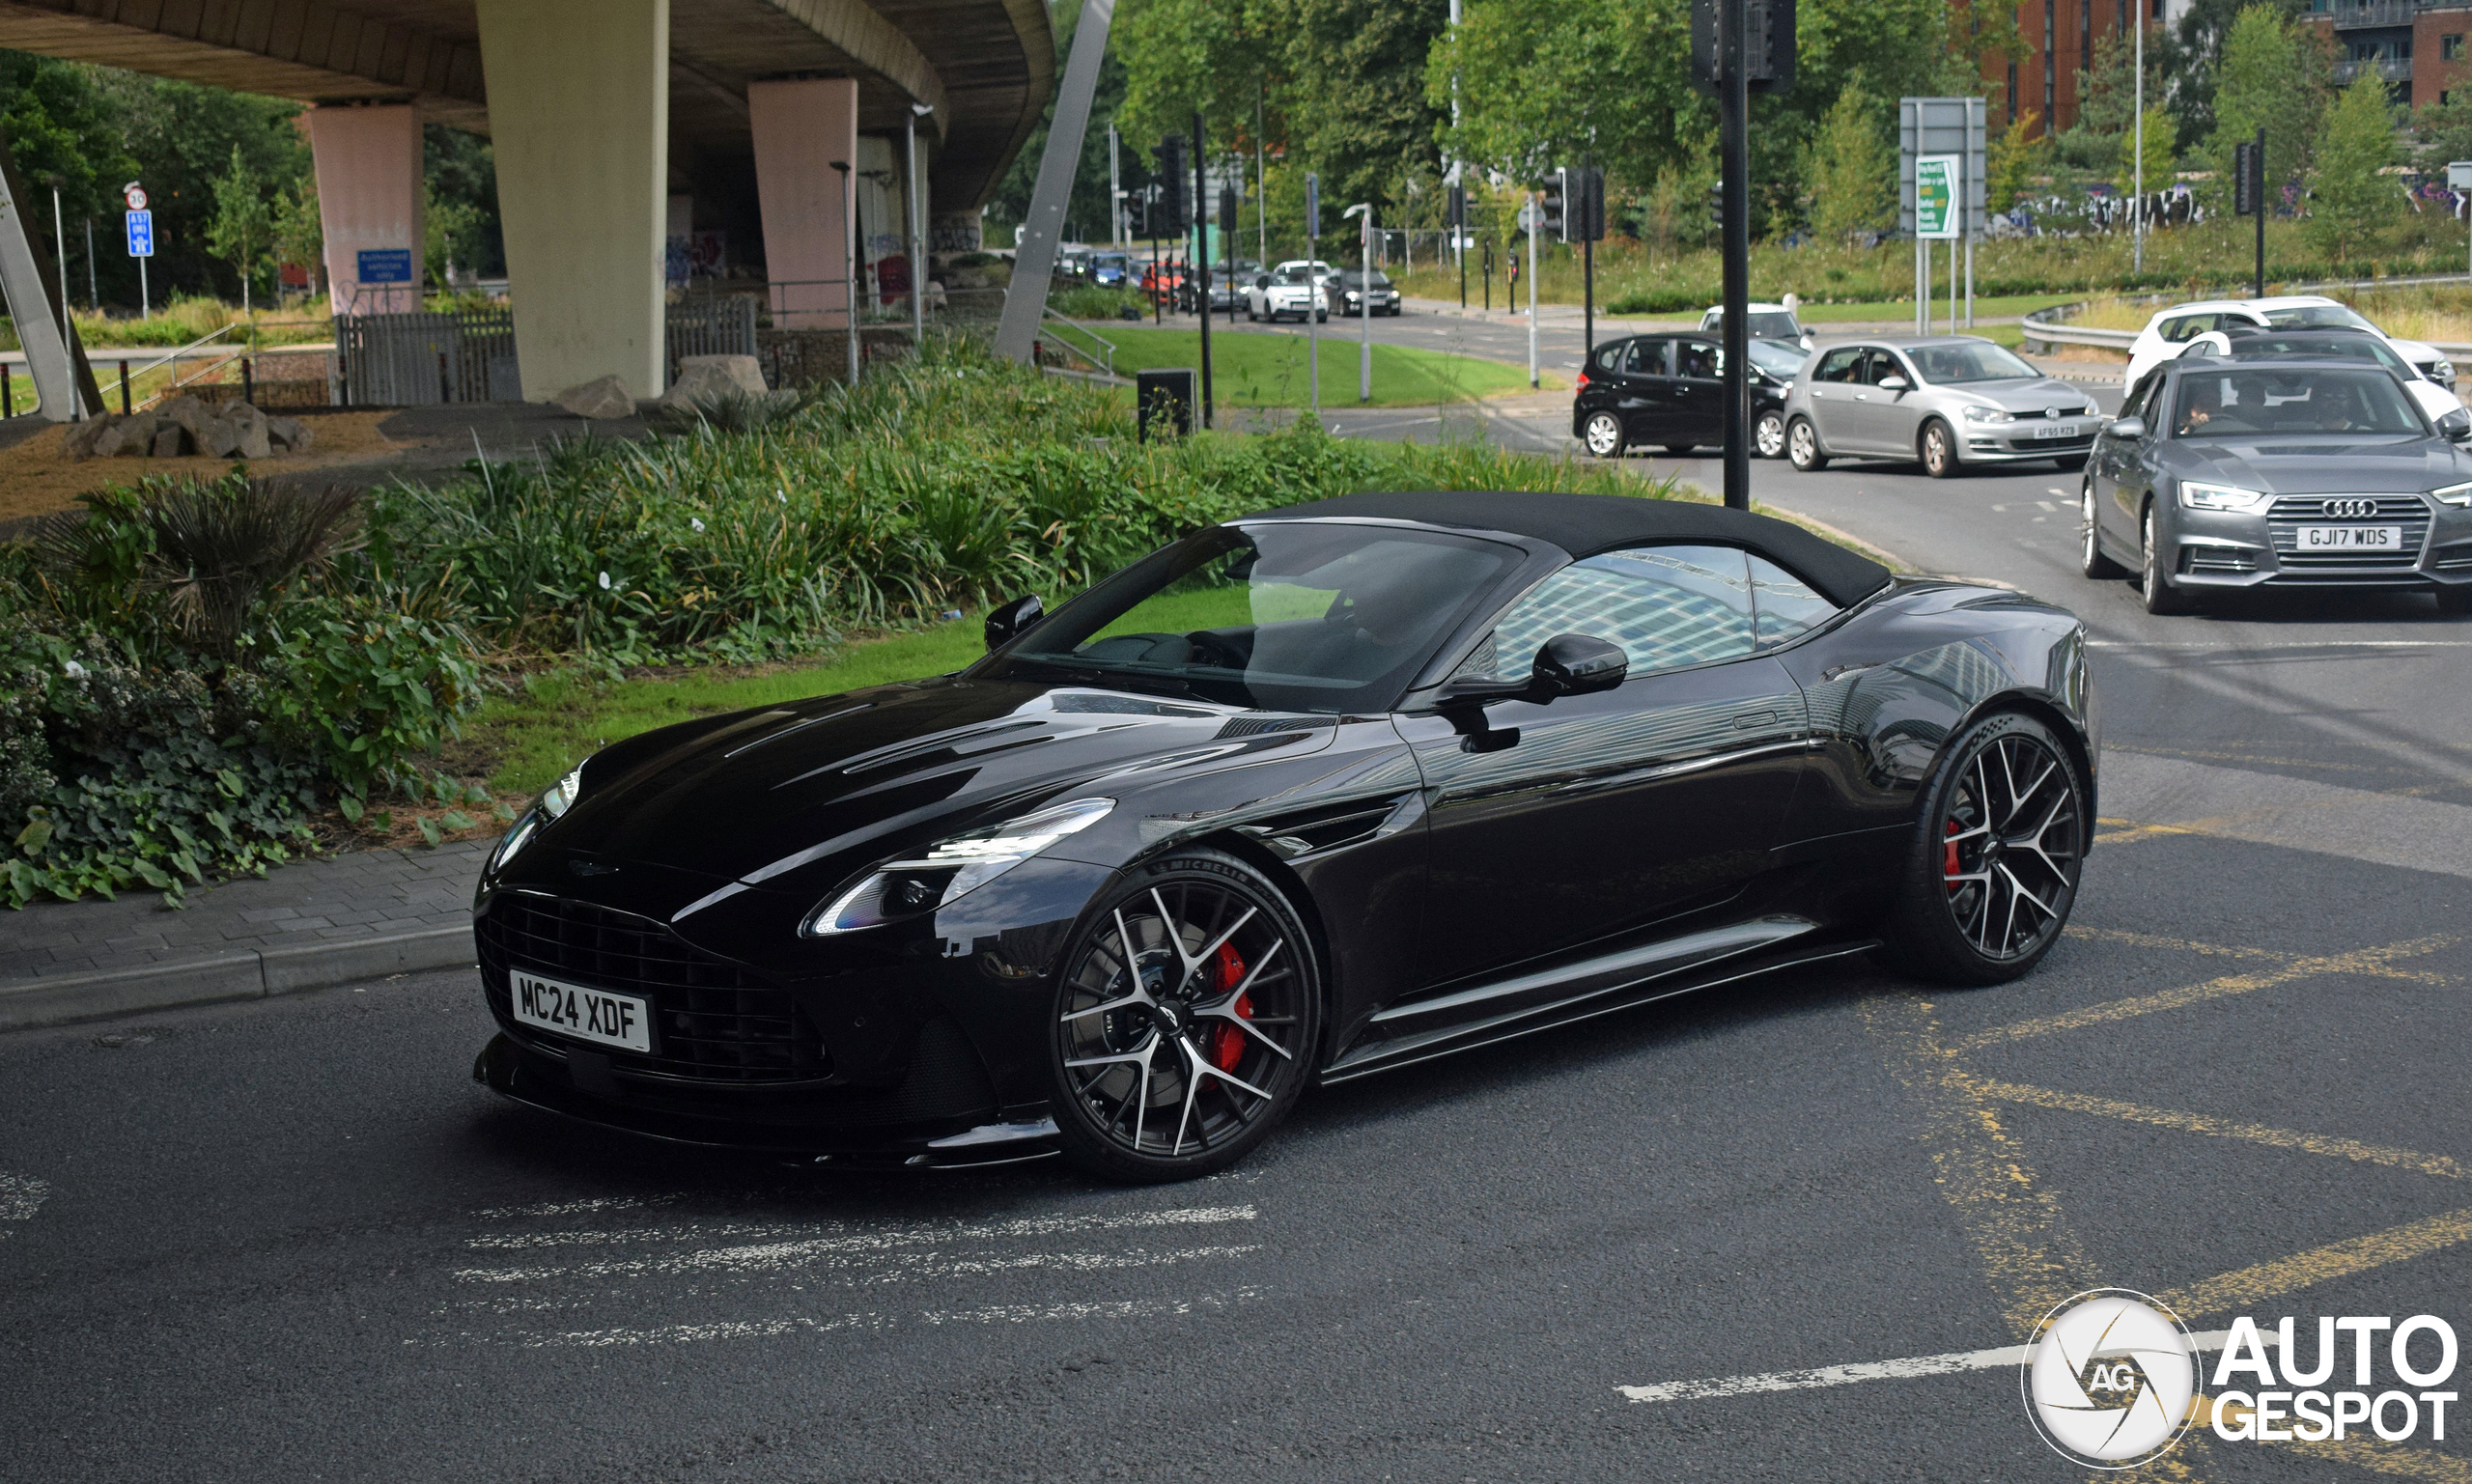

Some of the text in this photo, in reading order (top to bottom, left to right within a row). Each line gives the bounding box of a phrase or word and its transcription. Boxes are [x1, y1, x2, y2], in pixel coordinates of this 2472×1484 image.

[131, 194, 145, 205] 30
[2310, 529, 2388, 545] GJ17 WDS
[1170, 859, 1250, 882] MICHELIN
[520, 977, 635, 1039] MC24 XDF
